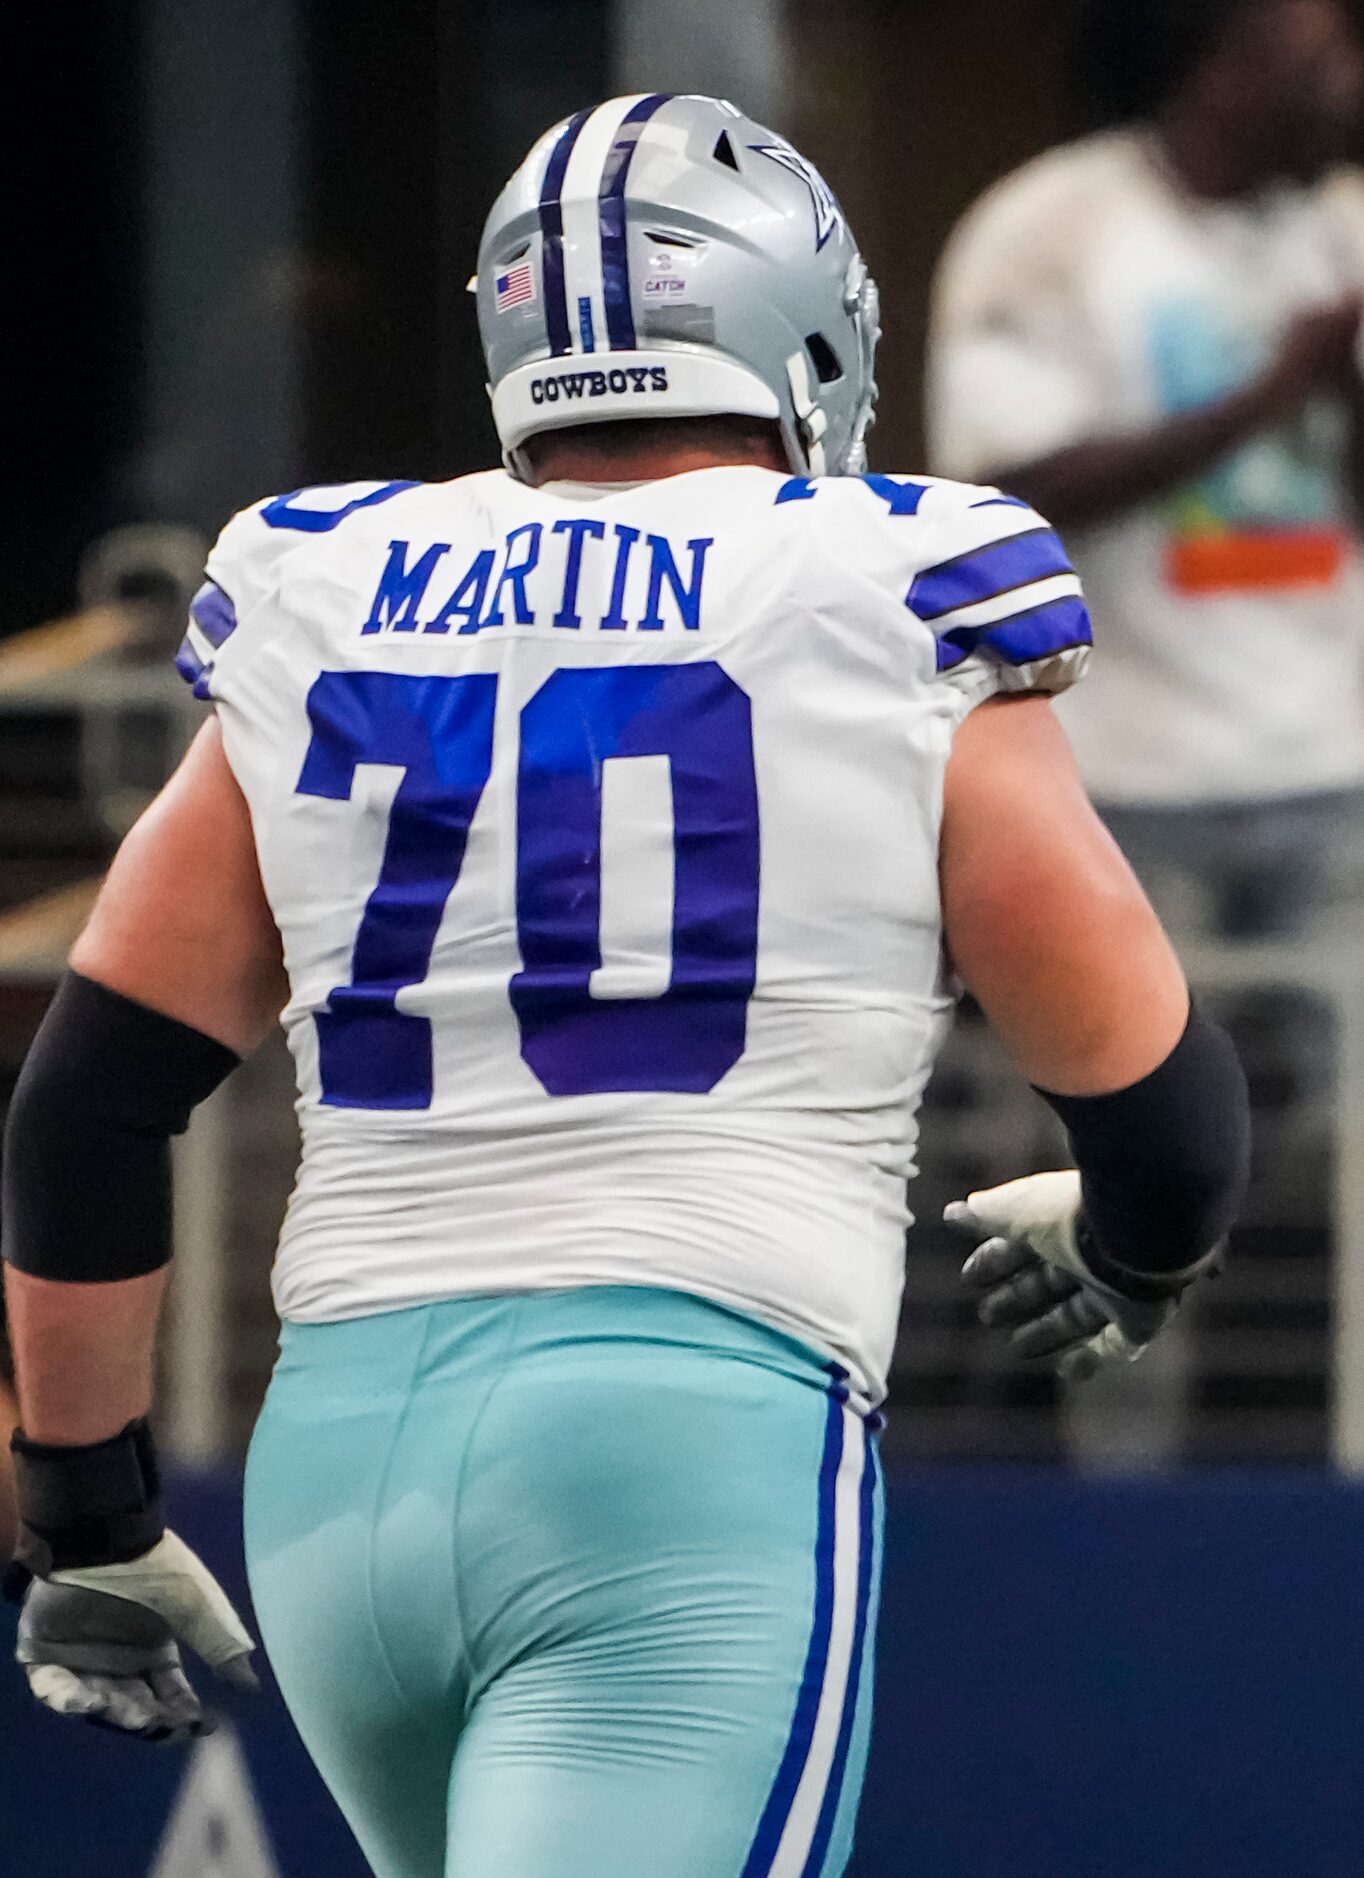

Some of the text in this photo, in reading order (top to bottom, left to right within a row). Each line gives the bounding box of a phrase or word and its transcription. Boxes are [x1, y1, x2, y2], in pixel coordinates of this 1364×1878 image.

[530, 367, 668, 405] COWBOYS
[361, 518, 714, 635] MARTIN
[295, 661, 759, 1110] 70
